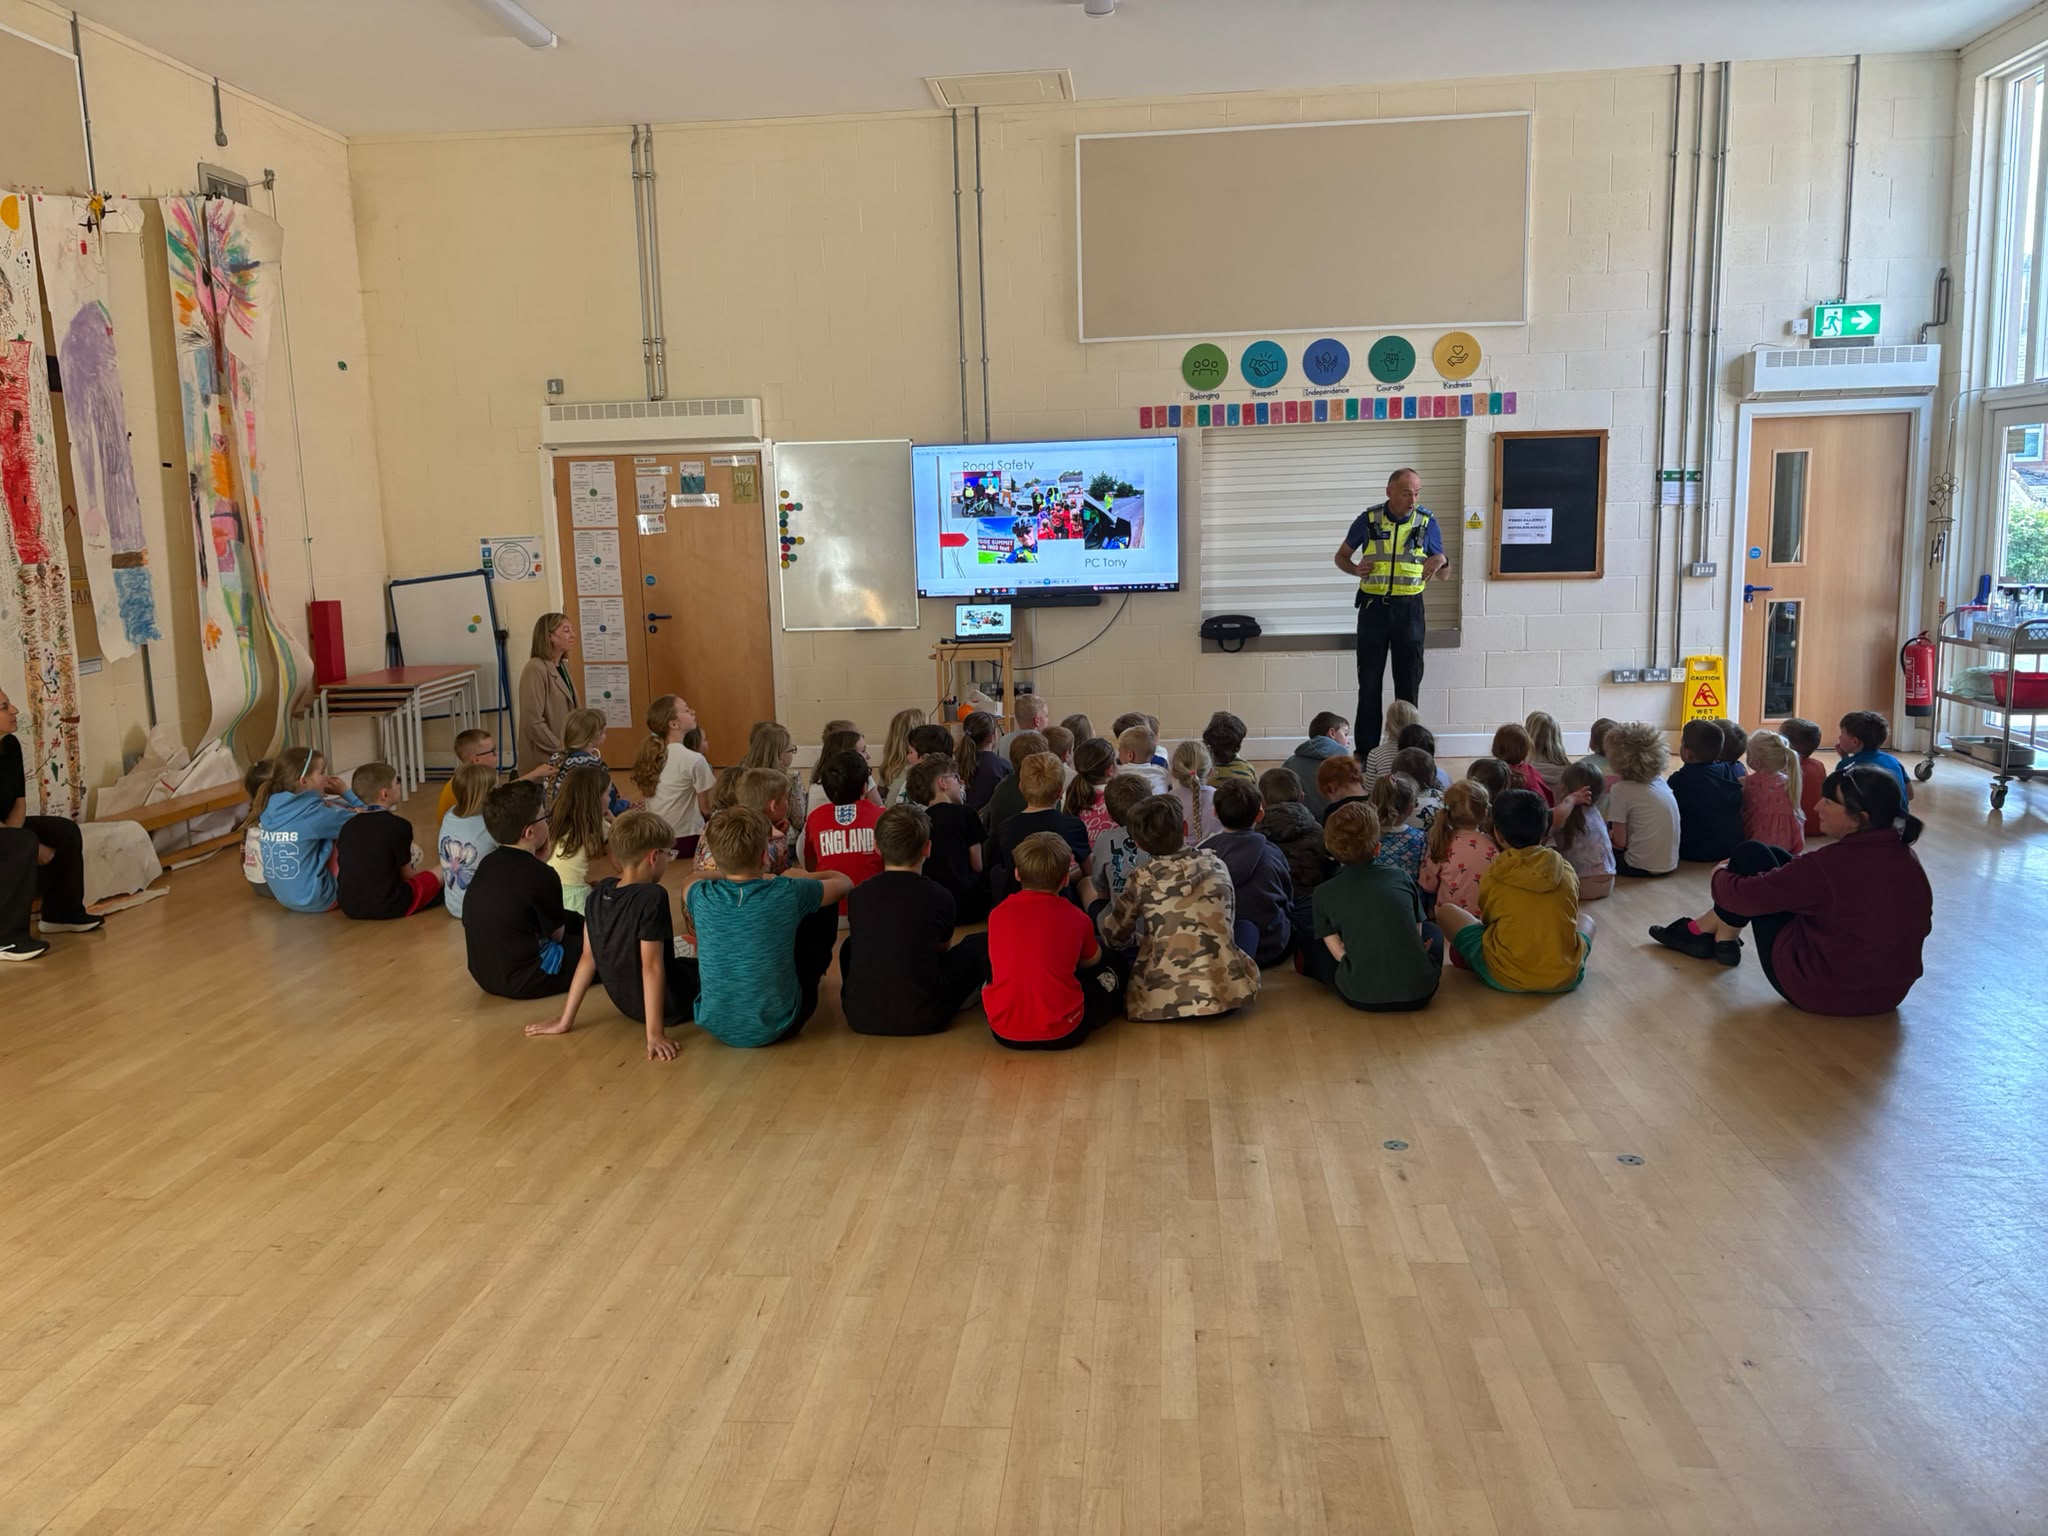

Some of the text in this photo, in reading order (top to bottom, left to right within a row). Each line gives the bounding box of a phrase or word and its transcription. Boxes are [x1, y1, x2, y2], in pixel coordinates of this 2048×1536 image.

[1376, 383, 1405, 393] Courage
[1443, 381, 1473, 390] Kindness
[1190, 391, 1220, 401] Belonging
[1252, 389, 1279, 398] Respect
[1304, 386, 1350, 397] Independence
[962, 458, 1035, 471] Road Safety
[1084, 557, 1128, 569] PC Tony
[260, 830, 299, 842] EAVERS
[819, 828, 875, 857] ENGLAND
